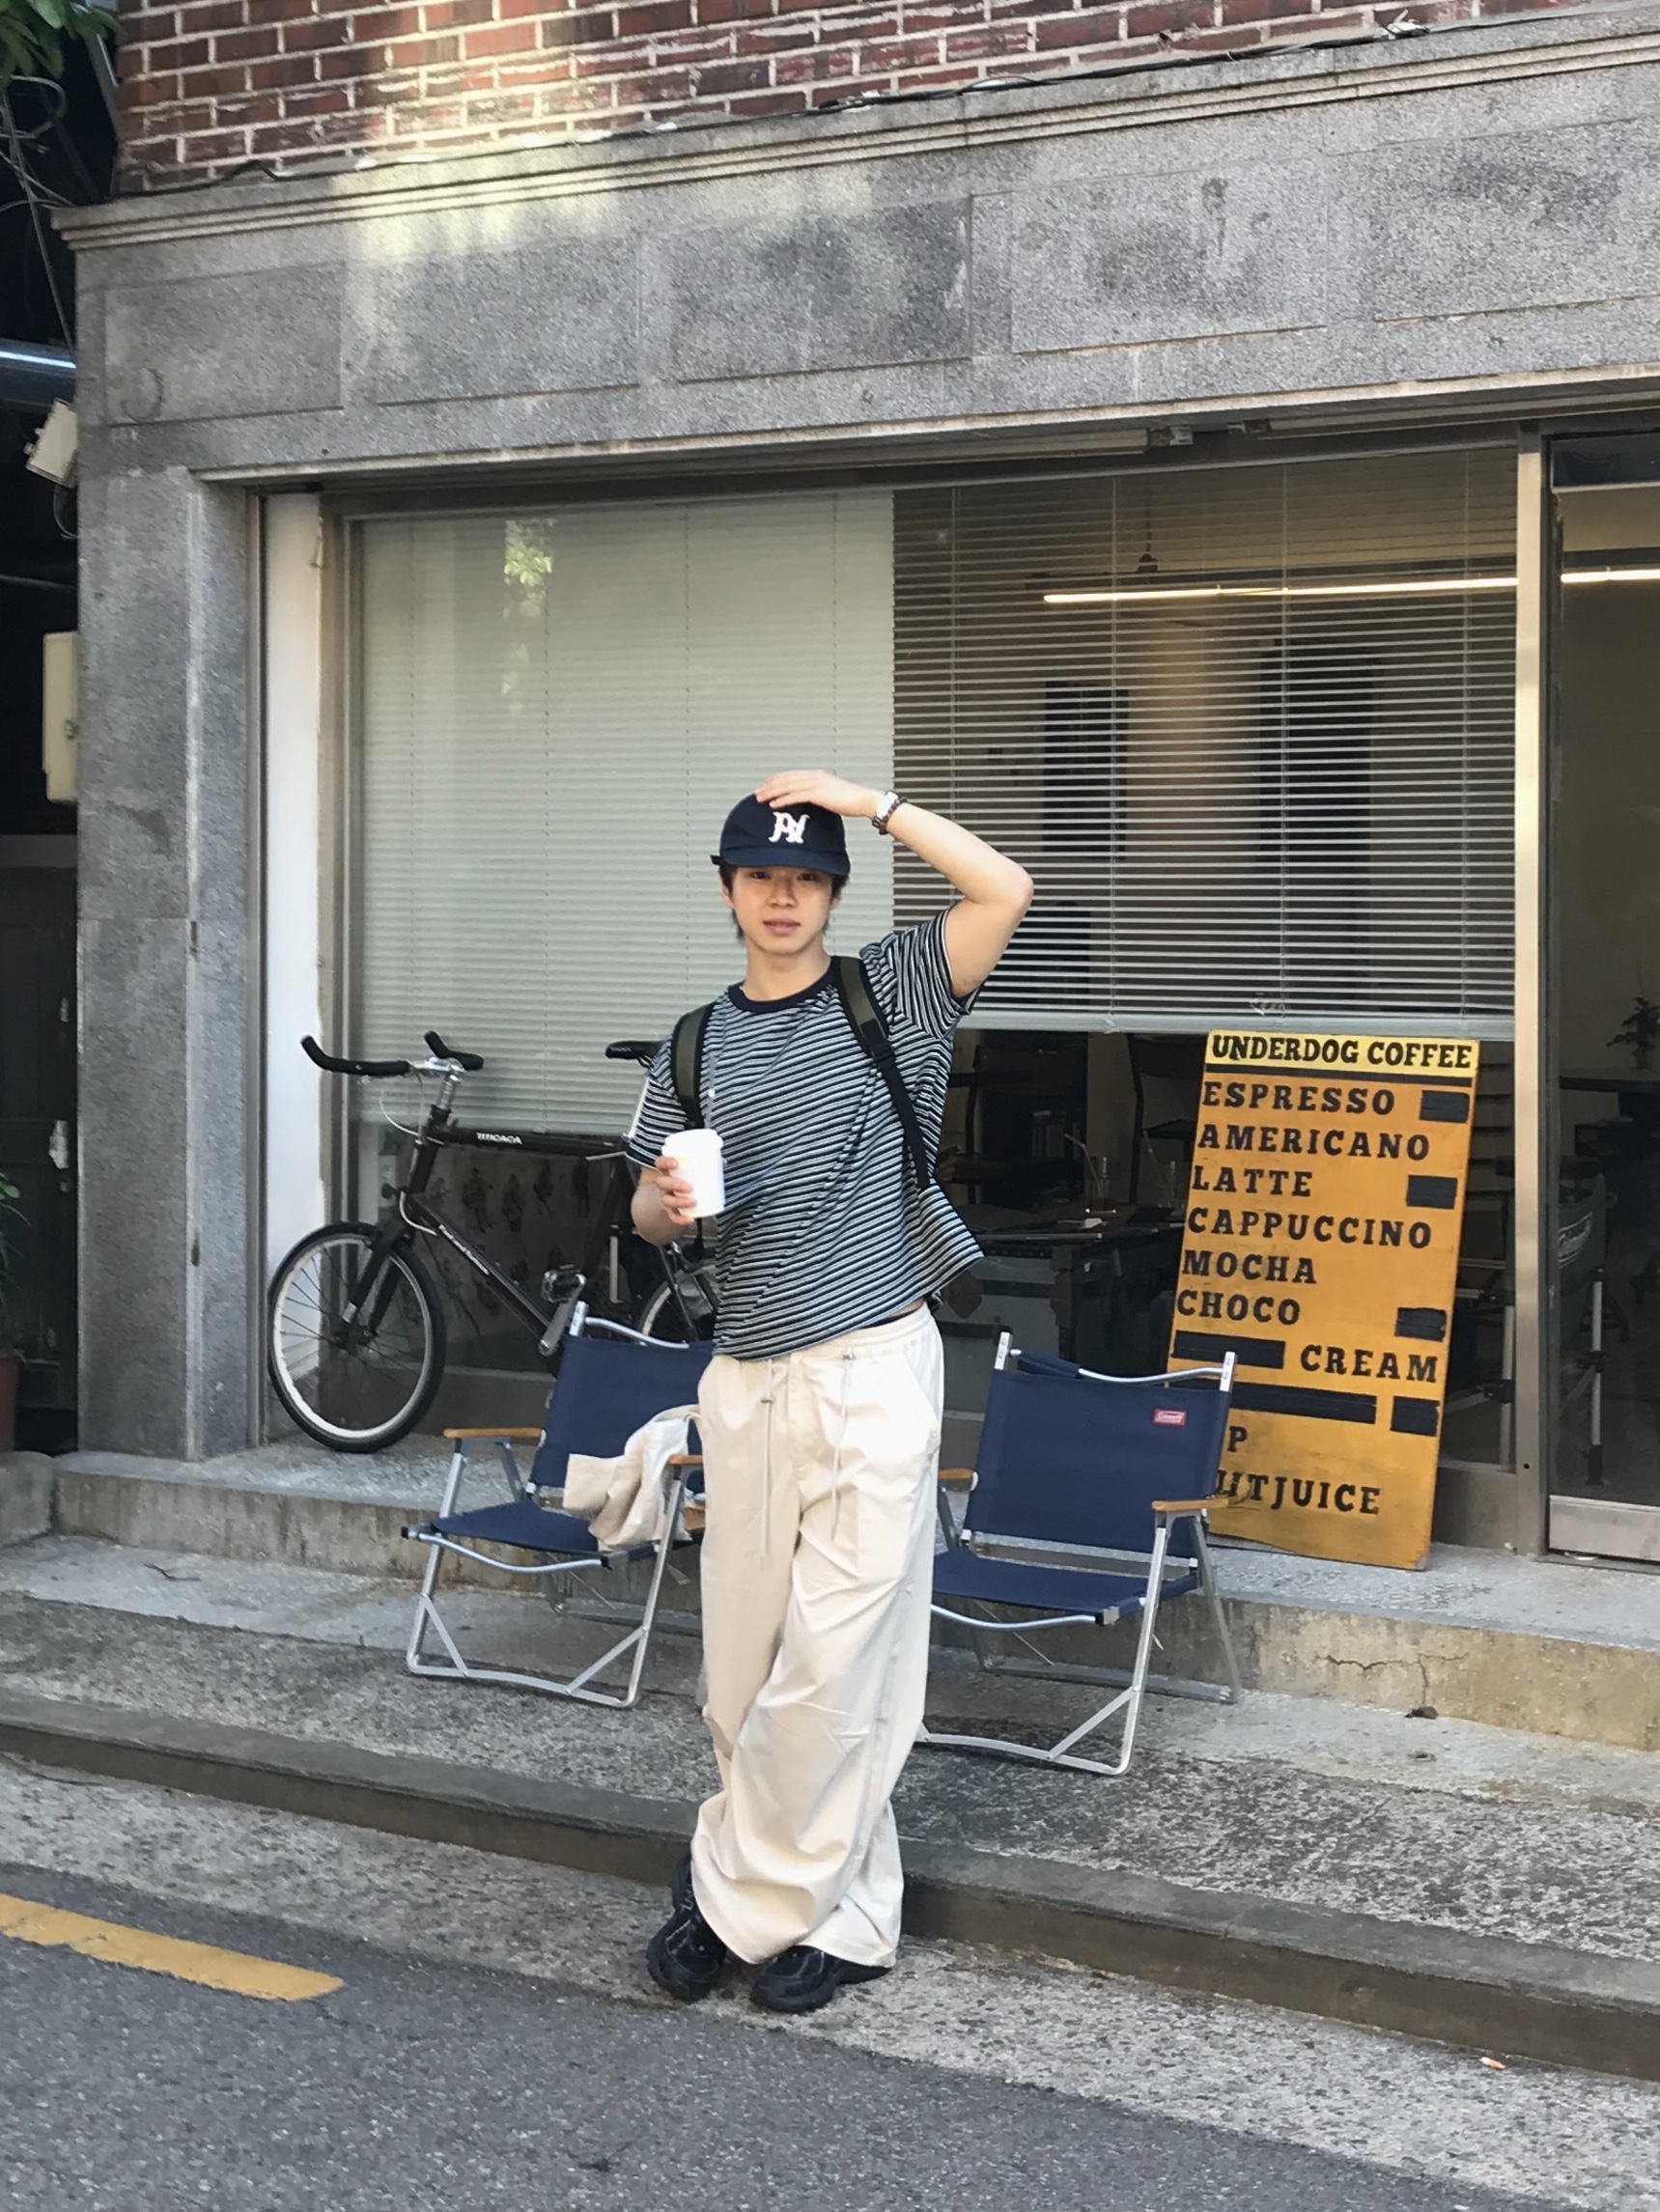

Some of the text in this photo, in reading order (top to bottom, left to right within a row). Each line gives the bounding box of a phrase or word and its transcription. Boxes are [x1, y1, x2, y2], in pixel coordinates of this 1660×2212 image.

[1212, 1035, 1473, 1069] UNDERDOG COFFEE
[1201, 1081, 1395, 1115] ESPRESSO
[1197, 1124, 1429, 1161] AMERICANO
[1192, 1165, 1313, 1197] LATTE
[1188, 1207, 1432, 1248] CAPPUCCINO
[1181, 1249, 1317, 1284] MOCHA
[1177, 1289, 1301, 1326] CHOCO
[1300, 1344, 1438, 1383] CREAM
